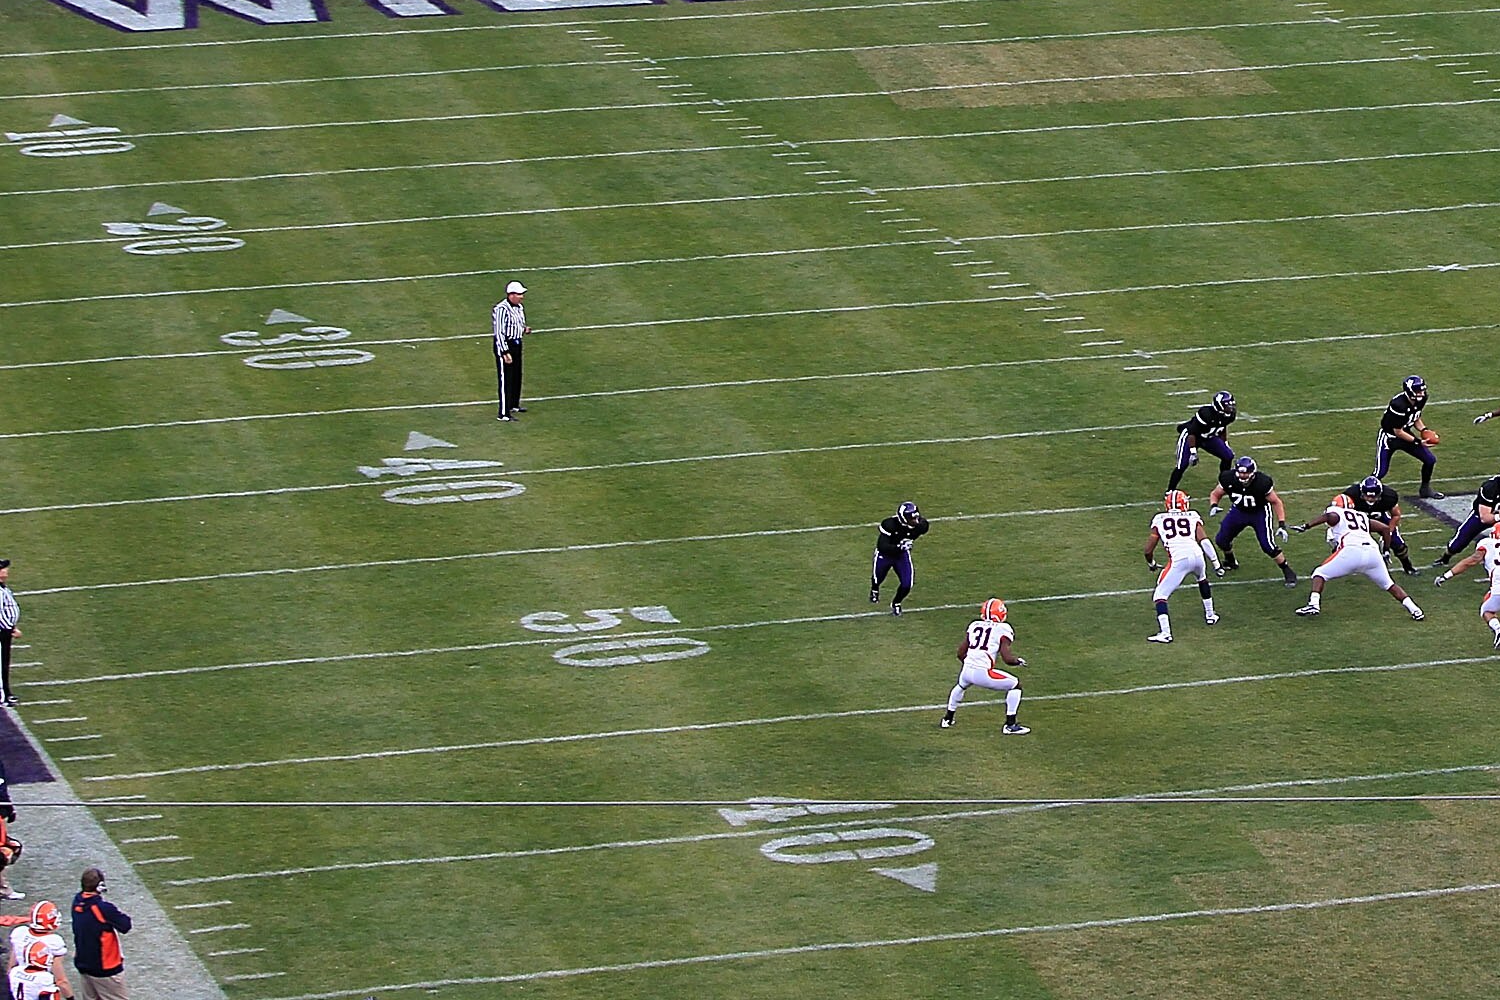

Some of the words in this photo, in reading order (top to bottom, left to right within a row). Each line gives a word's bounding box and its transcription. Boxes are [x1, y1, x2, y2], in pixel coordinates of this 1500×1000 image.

[1162, 517, 1191, 539] 99
[1344, 510, 1368, 531] 93
[969, 626, 993, 652] 31
